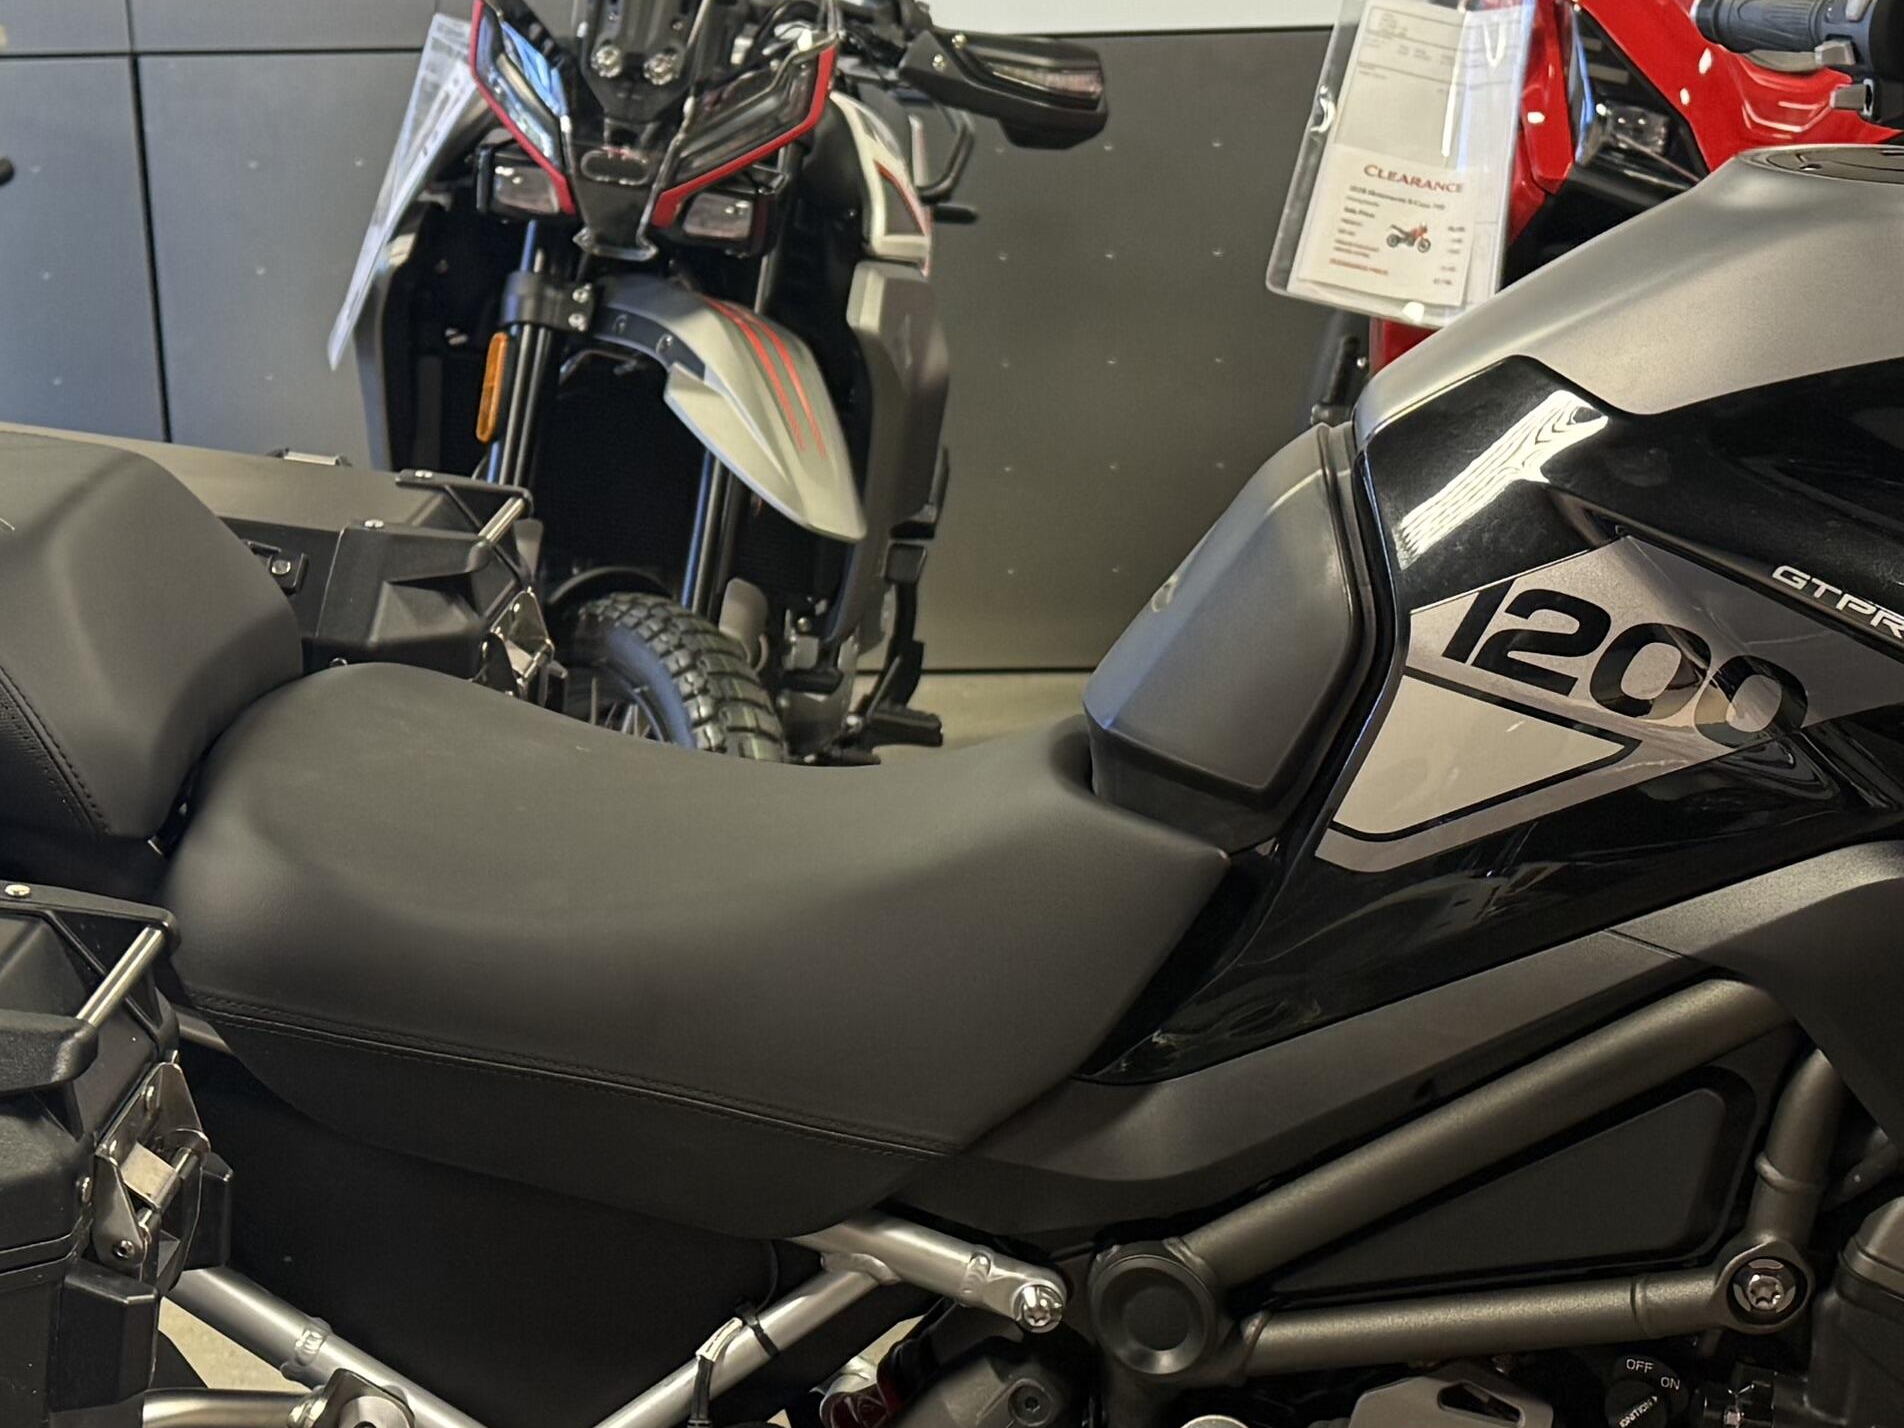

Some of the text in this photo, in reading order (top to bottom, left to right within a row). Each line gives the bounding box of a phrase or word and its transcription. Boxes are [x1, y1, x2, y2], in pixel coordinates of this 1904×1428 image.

[1363, 163, 1465, 194] CLEARANCE
[1441, 577, 1809, 749] 1200
[1626, 1358, 1654, 1373] OFF
[1660, 1376, 1680, 1390] ON
